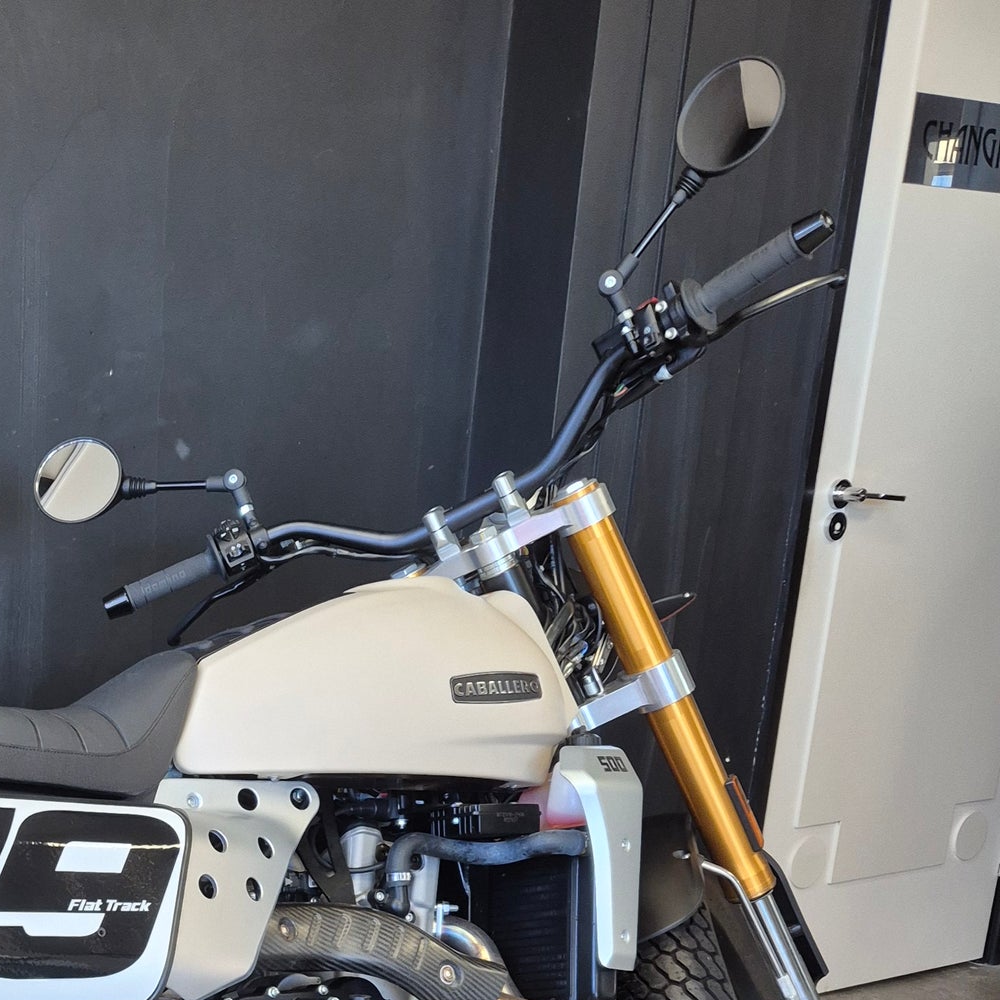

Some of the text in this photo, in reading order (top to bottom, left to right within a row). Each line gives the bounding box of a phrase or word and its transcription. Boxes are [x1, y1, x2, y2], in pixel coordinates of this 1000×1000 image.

[453, 679, 539, 697] CABALLERO
[596, 755, 629, 772] 500
[67, 898, 152, 912] Flat Track
